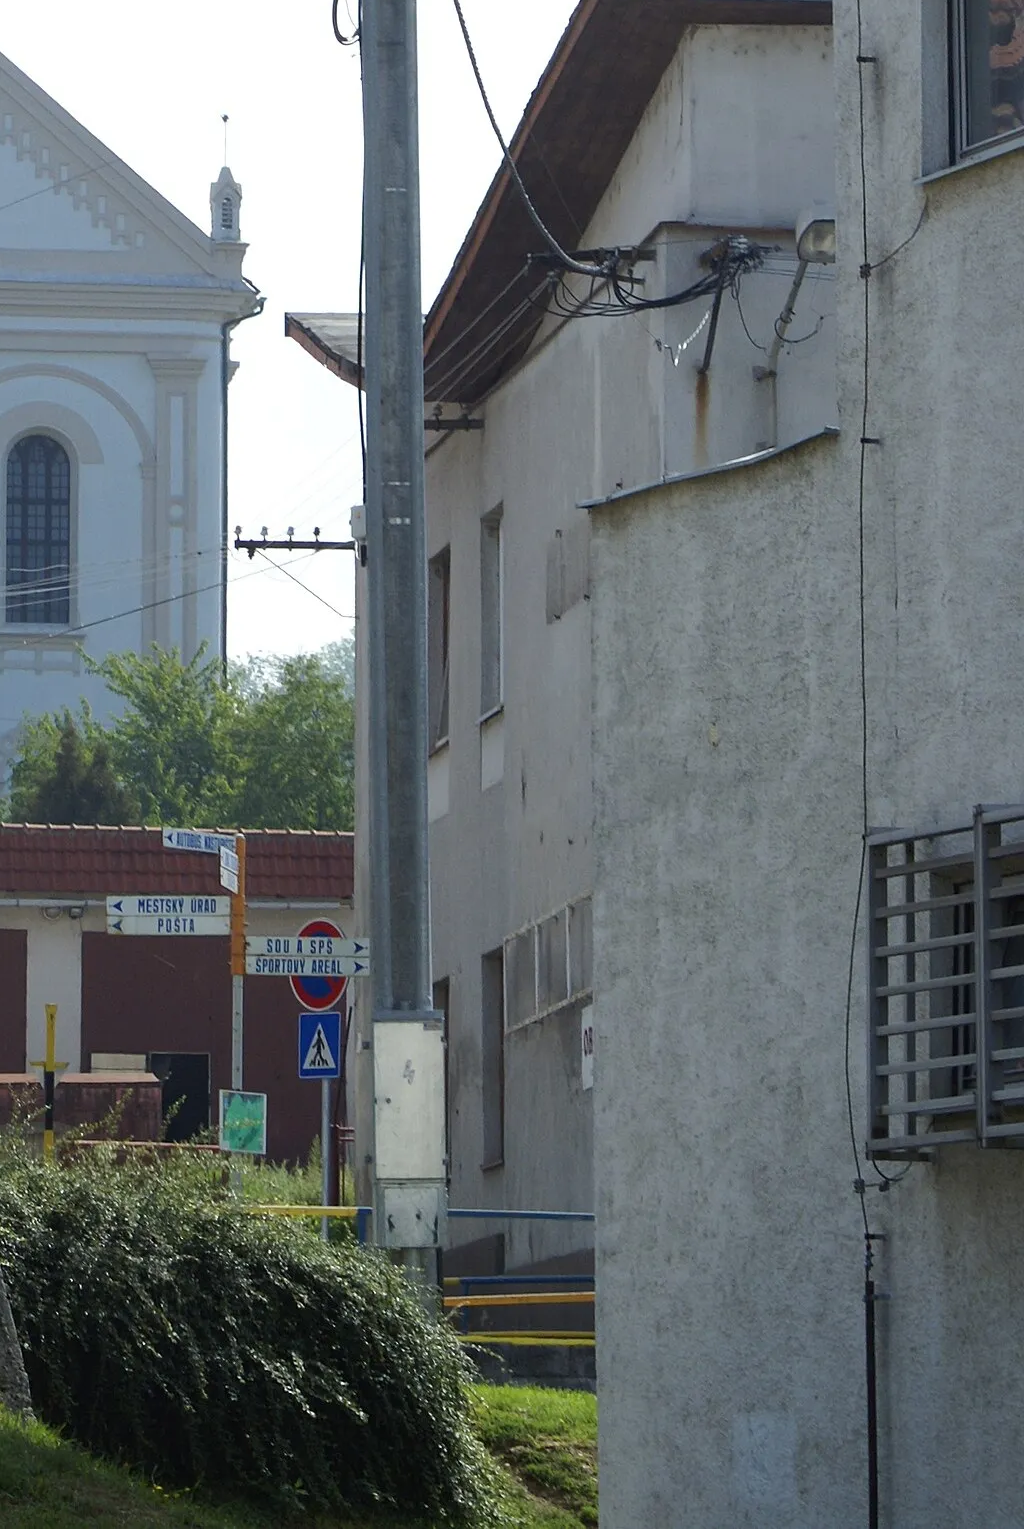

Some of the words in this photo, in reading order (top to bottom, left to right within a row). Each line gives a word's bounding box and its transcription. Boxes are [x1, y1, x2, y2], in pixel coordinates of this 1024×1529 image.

[138, 897, 184, 913] MESTSKÝ
[190, 897, 217, 913] ÚRAD
[158, 916, 195, 933] POŠTA
[267, 938, 290, 954] SOU
[296, 939, 303, 954] A
[310, 938, 333, 955] SPŠ
[255, 957, 306, 974] ŠPORTOVÝ
